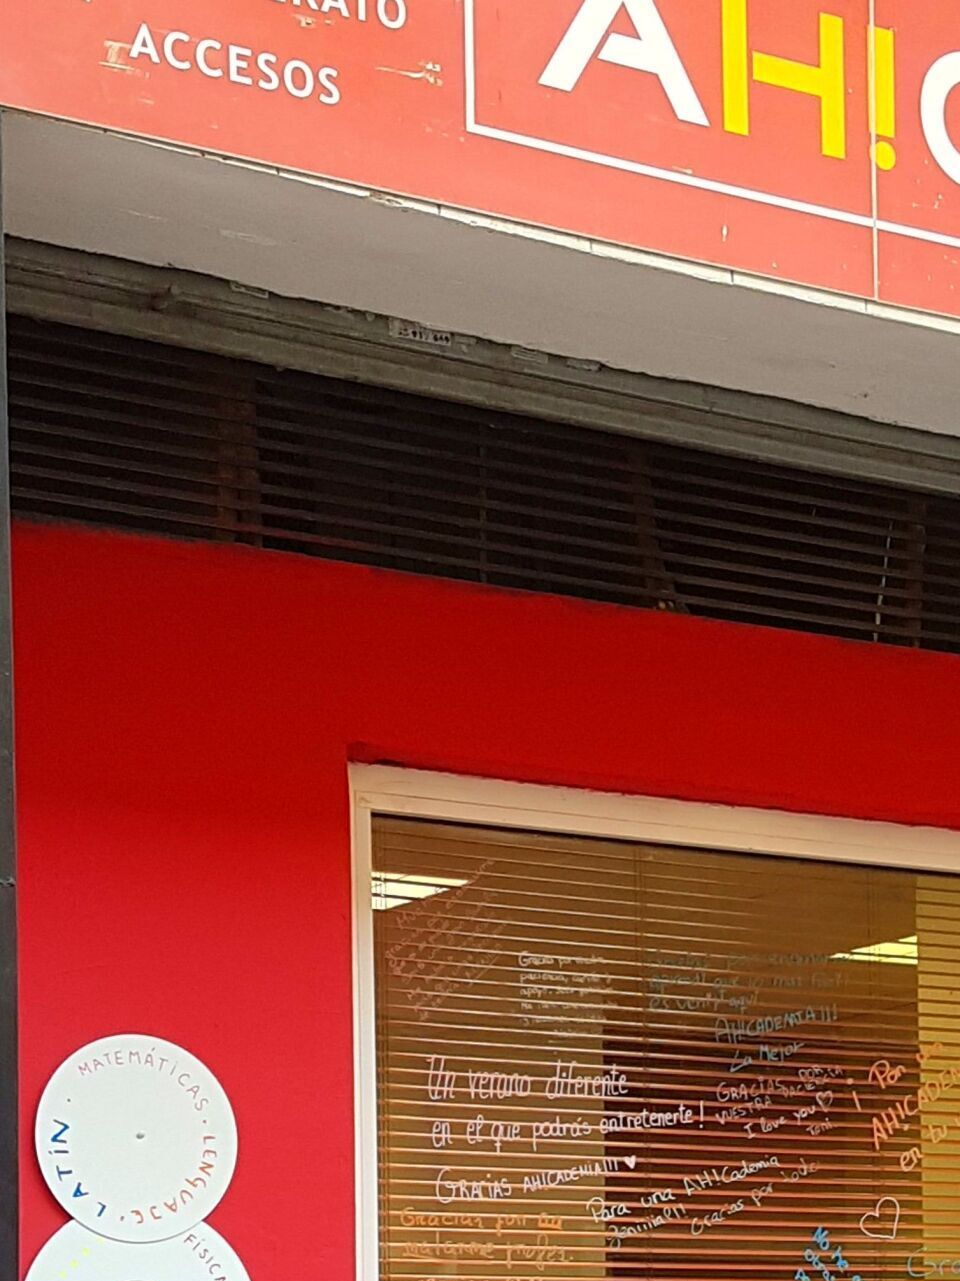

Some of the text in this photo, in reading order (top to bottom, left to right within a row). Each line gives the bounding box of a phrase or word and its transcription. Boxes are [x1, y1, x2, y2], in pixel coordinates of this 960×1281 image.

[129, 22, 341, 105] ACCESOS
[77, 1047, 209, 1112] MATEMÁTICAS
[468, 1068, 532, 1101] verano
[545, 1058, 629, 1100] diferente
[431, 1119, 452, 1148] en
[466, 1114, 485, 1145] el
[490, 1119, 521, 1154] que
[532, 1117, 592, 1152] podrás
[586, 1196, 631, 1224] Para
[640, 1188, 676, 1208] una
[751, 1184, 775, 1207] por
